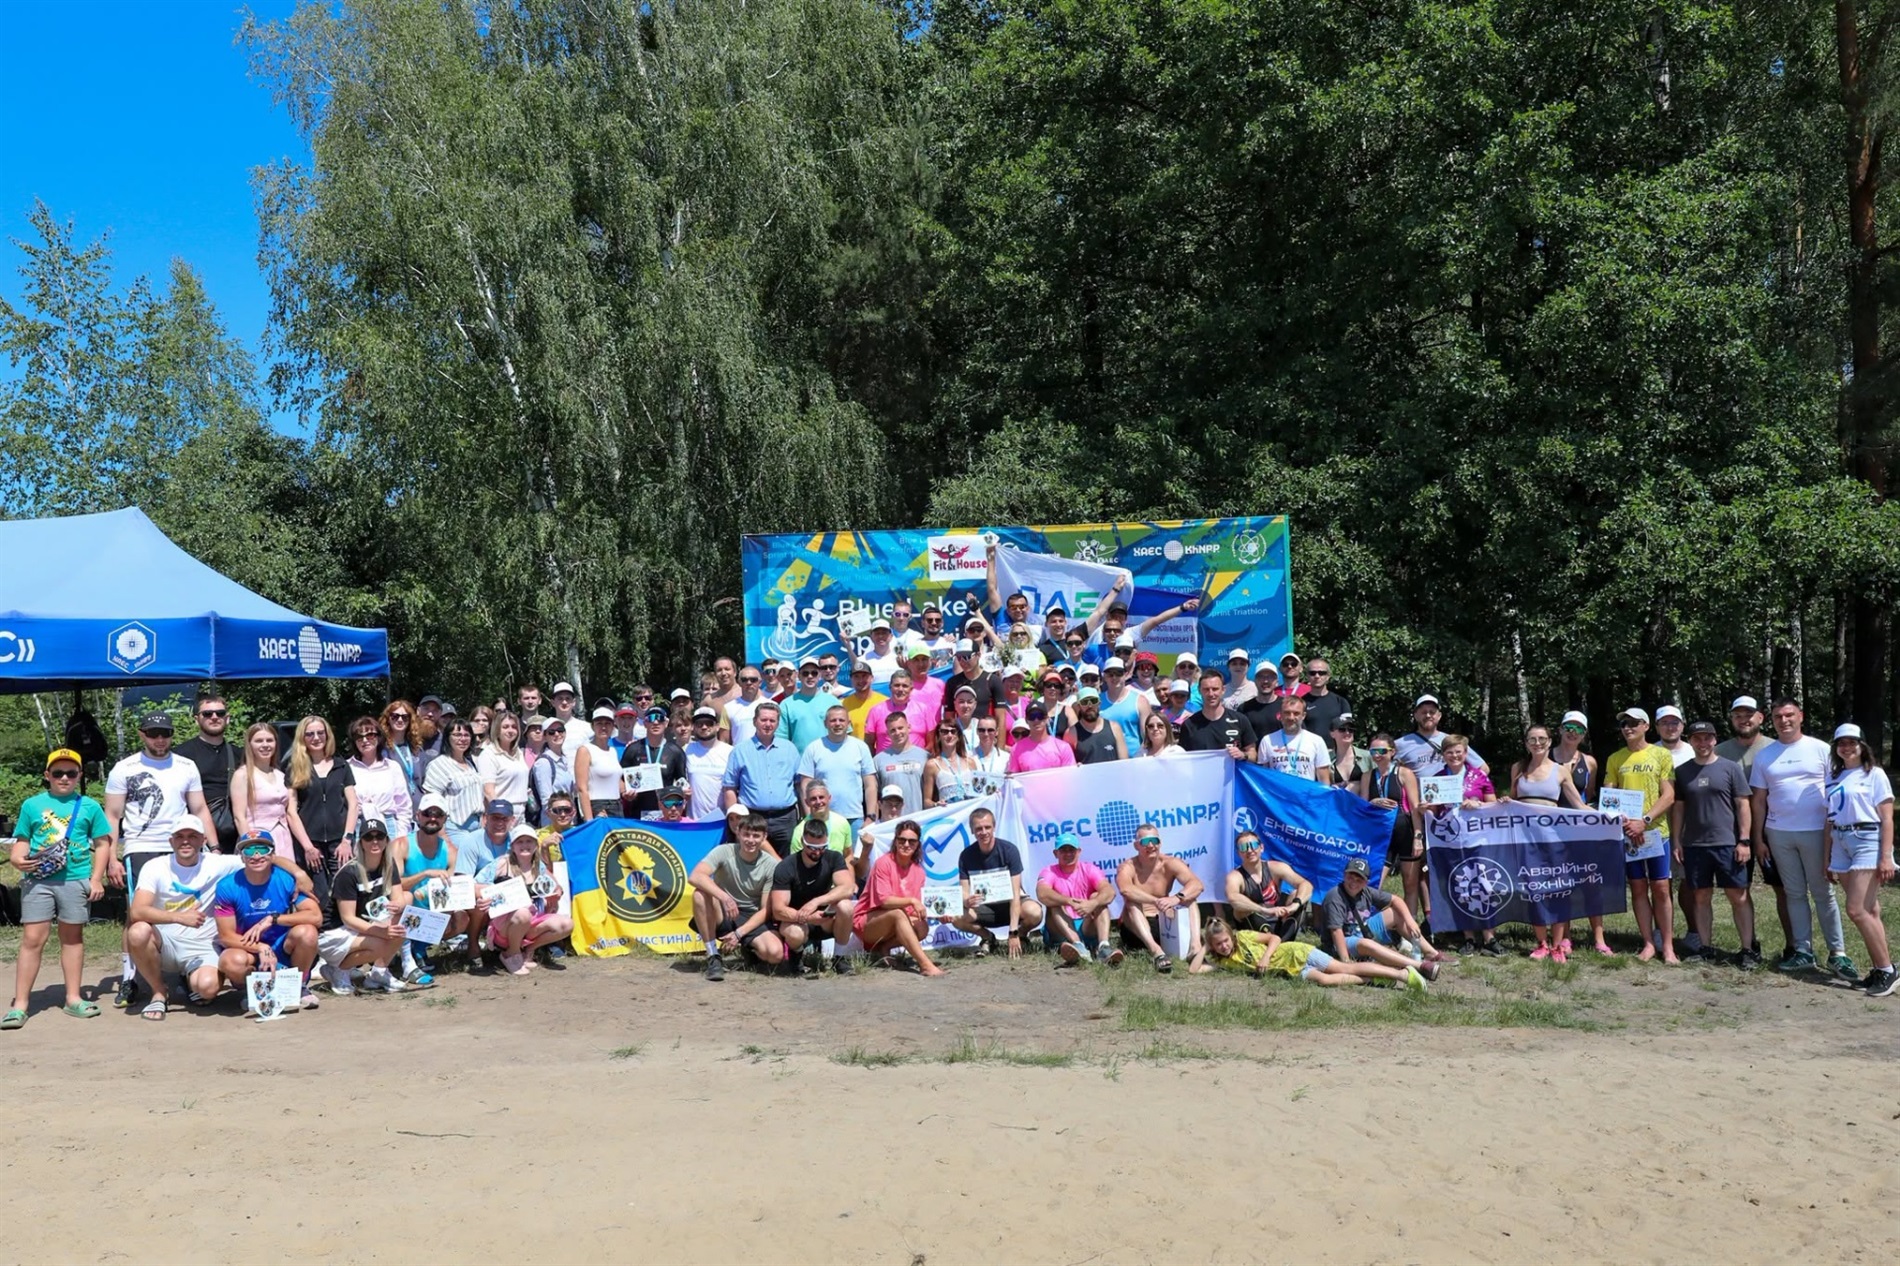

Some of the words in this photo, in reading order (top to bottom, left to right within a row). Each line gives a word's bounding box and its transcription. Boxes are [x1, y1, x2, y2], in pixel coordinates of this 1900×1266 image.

[933, 560, 947, 571] Fit
[956, 559, 988, 570] House
[906, 596, 980, 618] Lake
[1233, 608, 1269, 616] Triathlon
[1633, 764, 1654, 773] RUN
[1466, 814, 1620, 833] ЕНЕРГОАТОМ
[1263, 816, 1371, 856] ЕНЕРГОАТОМ
[627, 833, 662, 847] ГВАРДІЯ
[662, 846, 684, 877] УКРАЇНИ
[1166, 846, 1208, 860] ОМНА
[1517, 862, 1598, 877] Аварійно
[1518, 873, 1603, 891] технічний
[1520, 889, 1572, 903] центр
[635, 934, 692, 946] ЧАСТИНА
